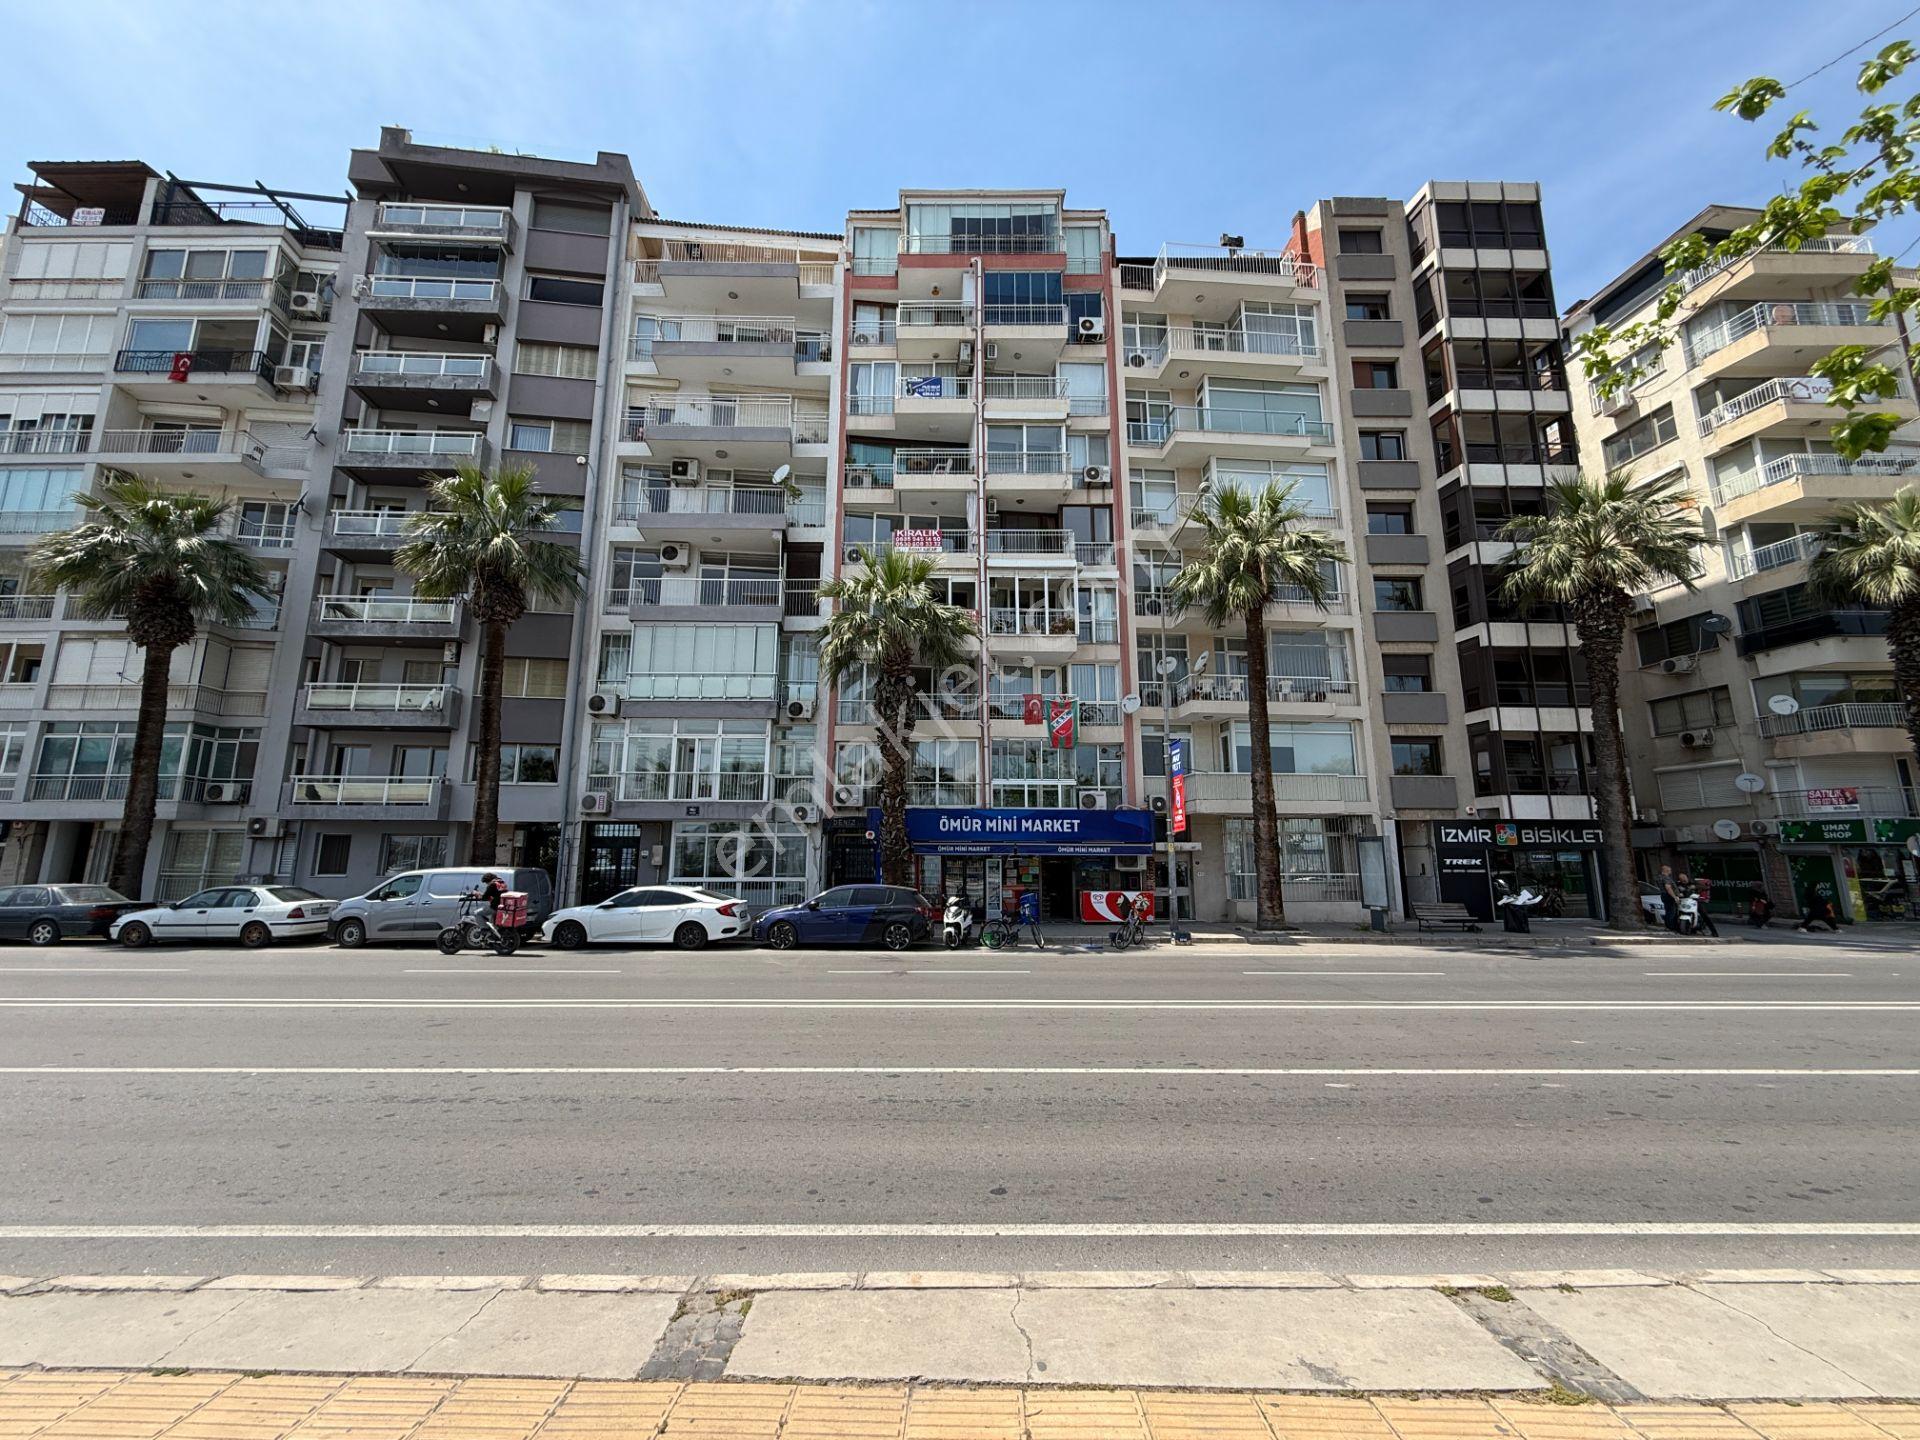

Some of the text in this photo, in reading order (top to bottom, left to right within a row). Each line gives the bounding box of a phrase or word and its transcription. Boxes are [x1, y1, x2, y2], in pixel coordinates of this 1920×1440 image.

[939, 816, 1081, 832] ÖMÜR MİNİ MARKET
[1822, 823, 1850, 831] UMAY
[1441, 826, 1603, 843] İZMİR BİSİKLET
[1823, 831, 1852, 839] SHOP
